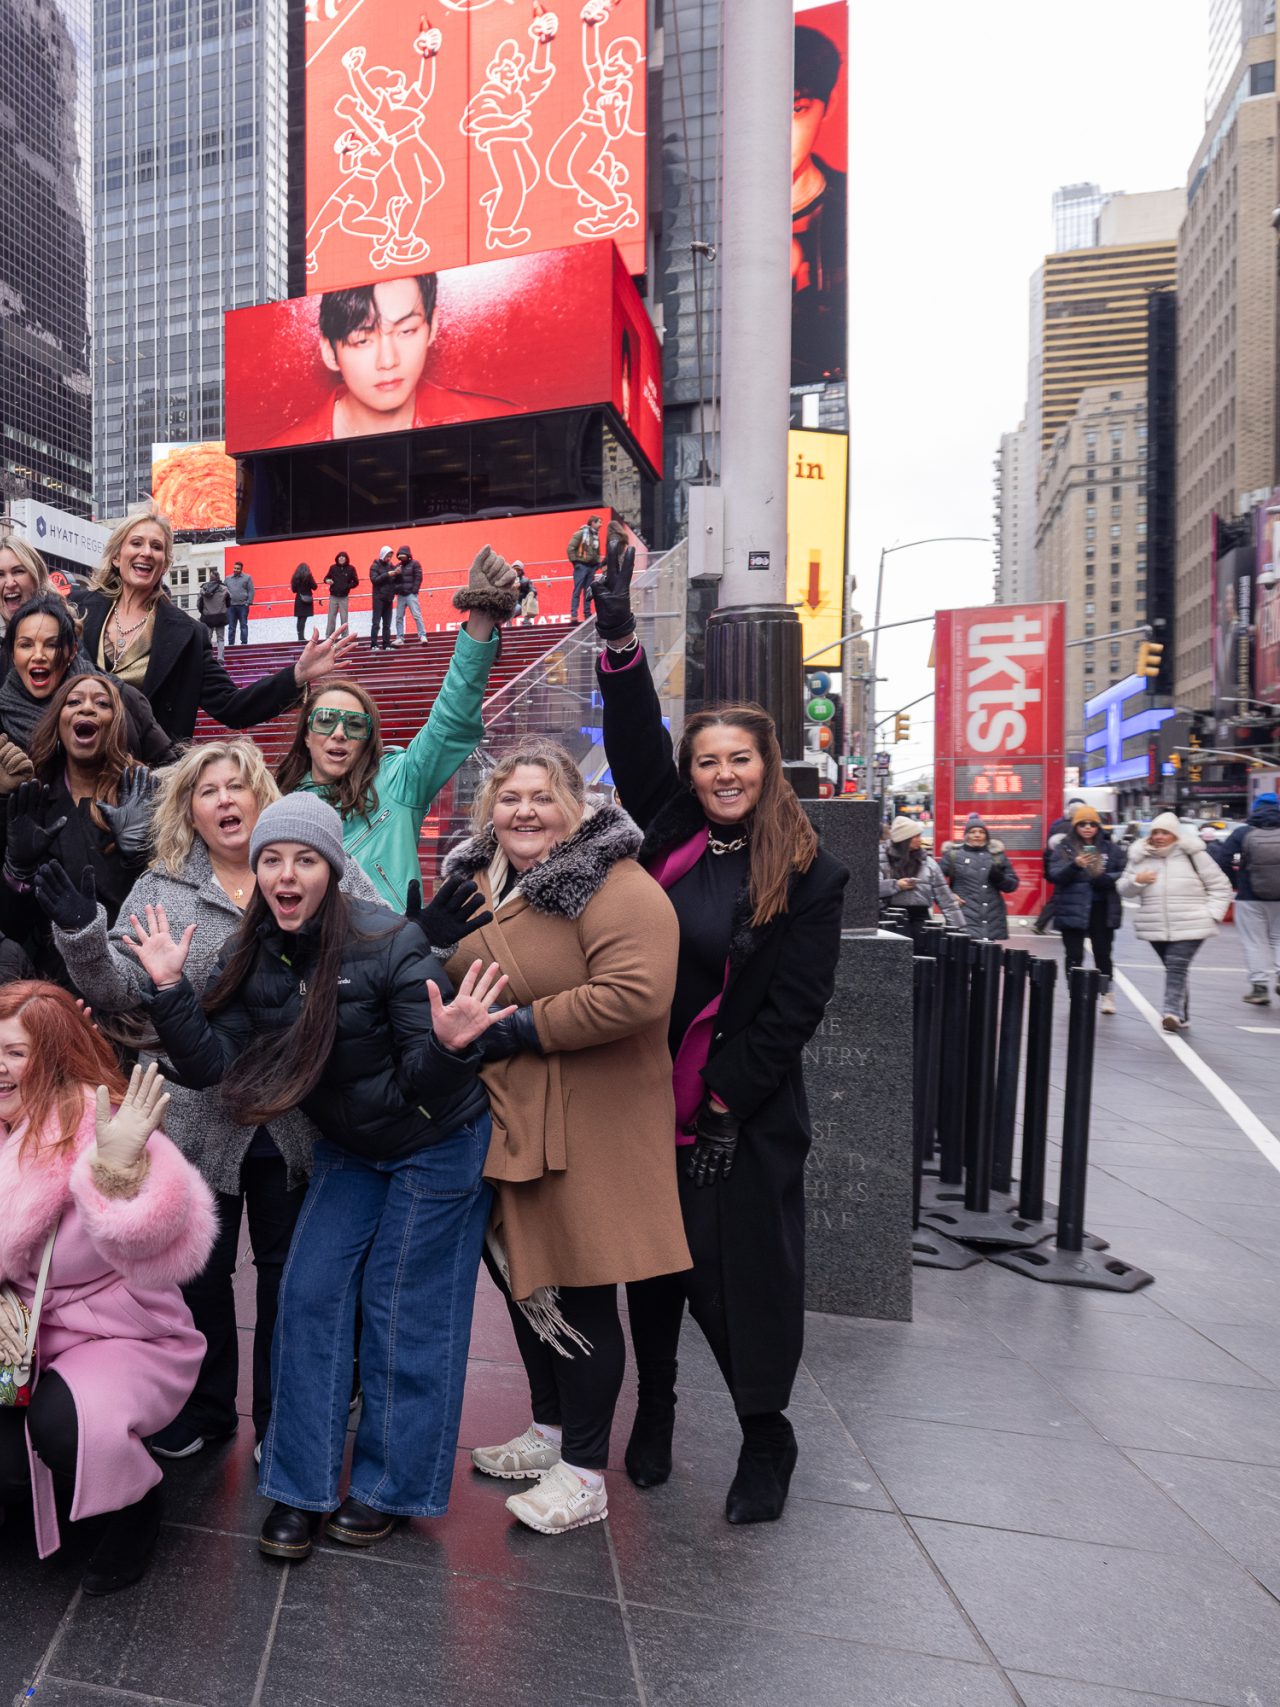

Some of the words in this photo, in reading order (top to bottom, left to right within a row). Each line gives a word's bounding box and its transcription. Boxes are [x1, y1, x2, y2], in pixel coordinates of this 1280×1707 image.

[795, 454, 825, 480] in
[50, 524, 79, 545] HYATT
[81, 536, 105, 554] REGE
[967, 614, 1046, 753] tkts
